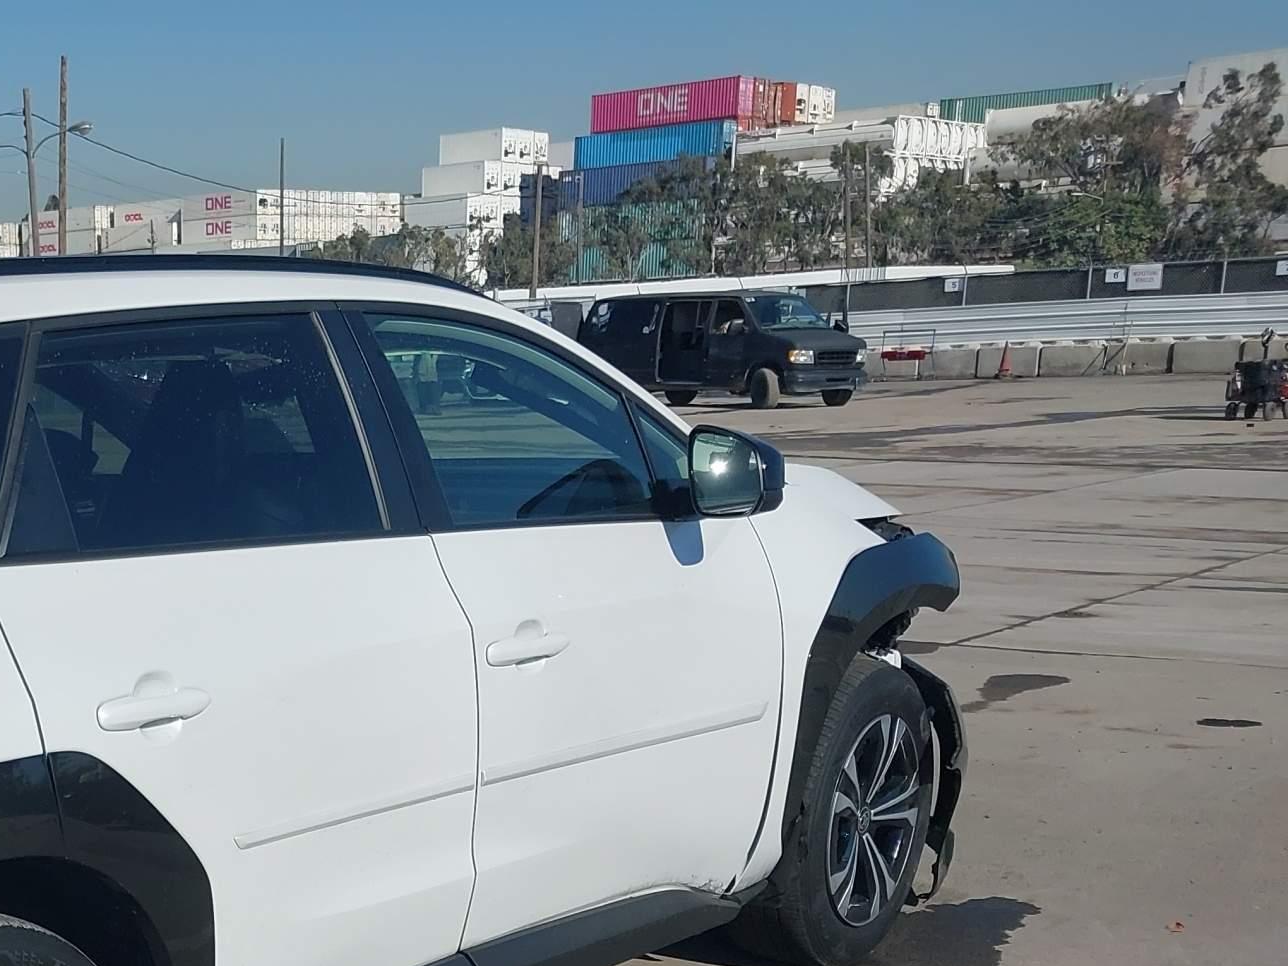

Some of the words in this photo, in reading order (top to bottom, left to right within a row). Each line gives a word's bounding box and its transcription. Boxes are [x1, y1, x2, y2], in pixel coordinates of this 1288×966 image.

[637, 89, 688, 116] ONE
[205, 195, 231, 211] ONE
[205, 221, 231, 236] ONE
